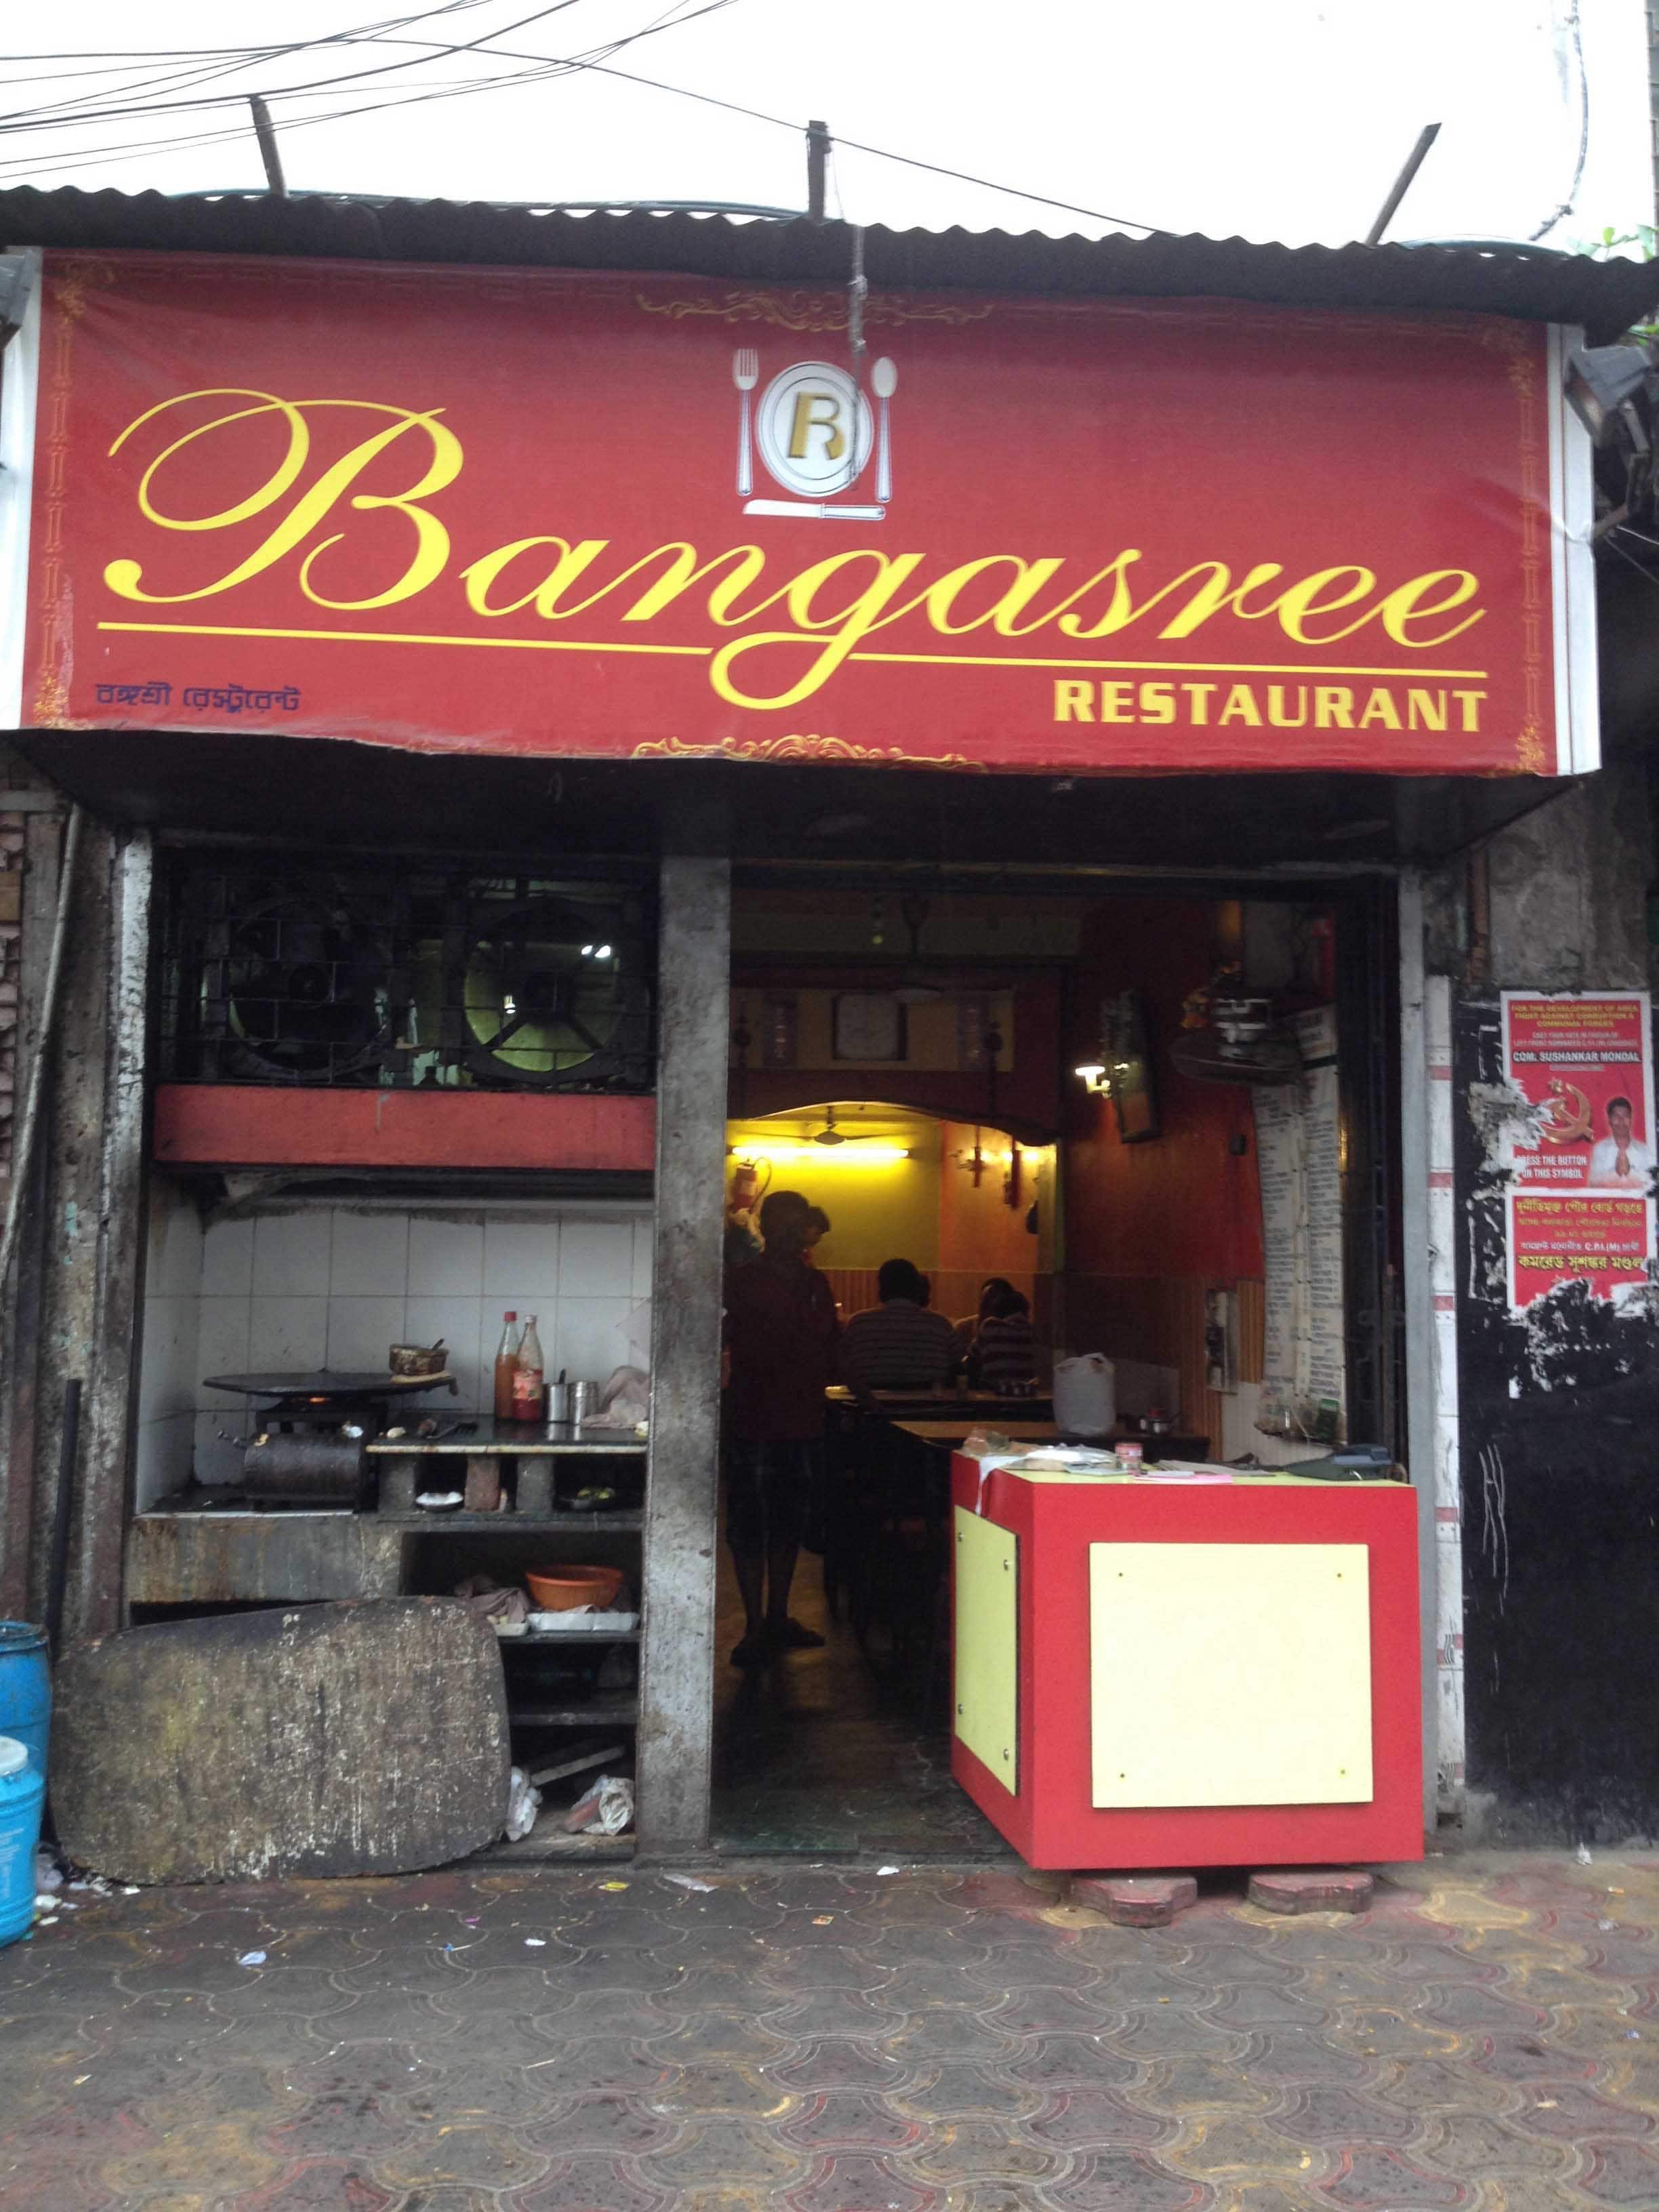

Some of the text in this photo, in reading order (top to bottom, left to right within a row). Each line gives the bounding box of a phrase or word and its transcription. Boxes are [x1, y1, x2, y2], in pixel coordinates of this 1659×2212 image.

[788, 392, 846, 460] R
[103, 388, 1486, 710] Bangasree
[95, 681, 172, 706] বঙ্গশ্রী
[1054, 680, 1487, 732] RESTAURANT
[1513, 1051, 1640, 1062] COM. SUSHANKAR MONDAL
[1542, 1155, 1557, 1166] THE
[1557, 1155, 1587, 1166] BUTTON
[1534, 1168, 1551, 1179] THIS
[1552, 1168, 1584, 1179] SYMBOL
